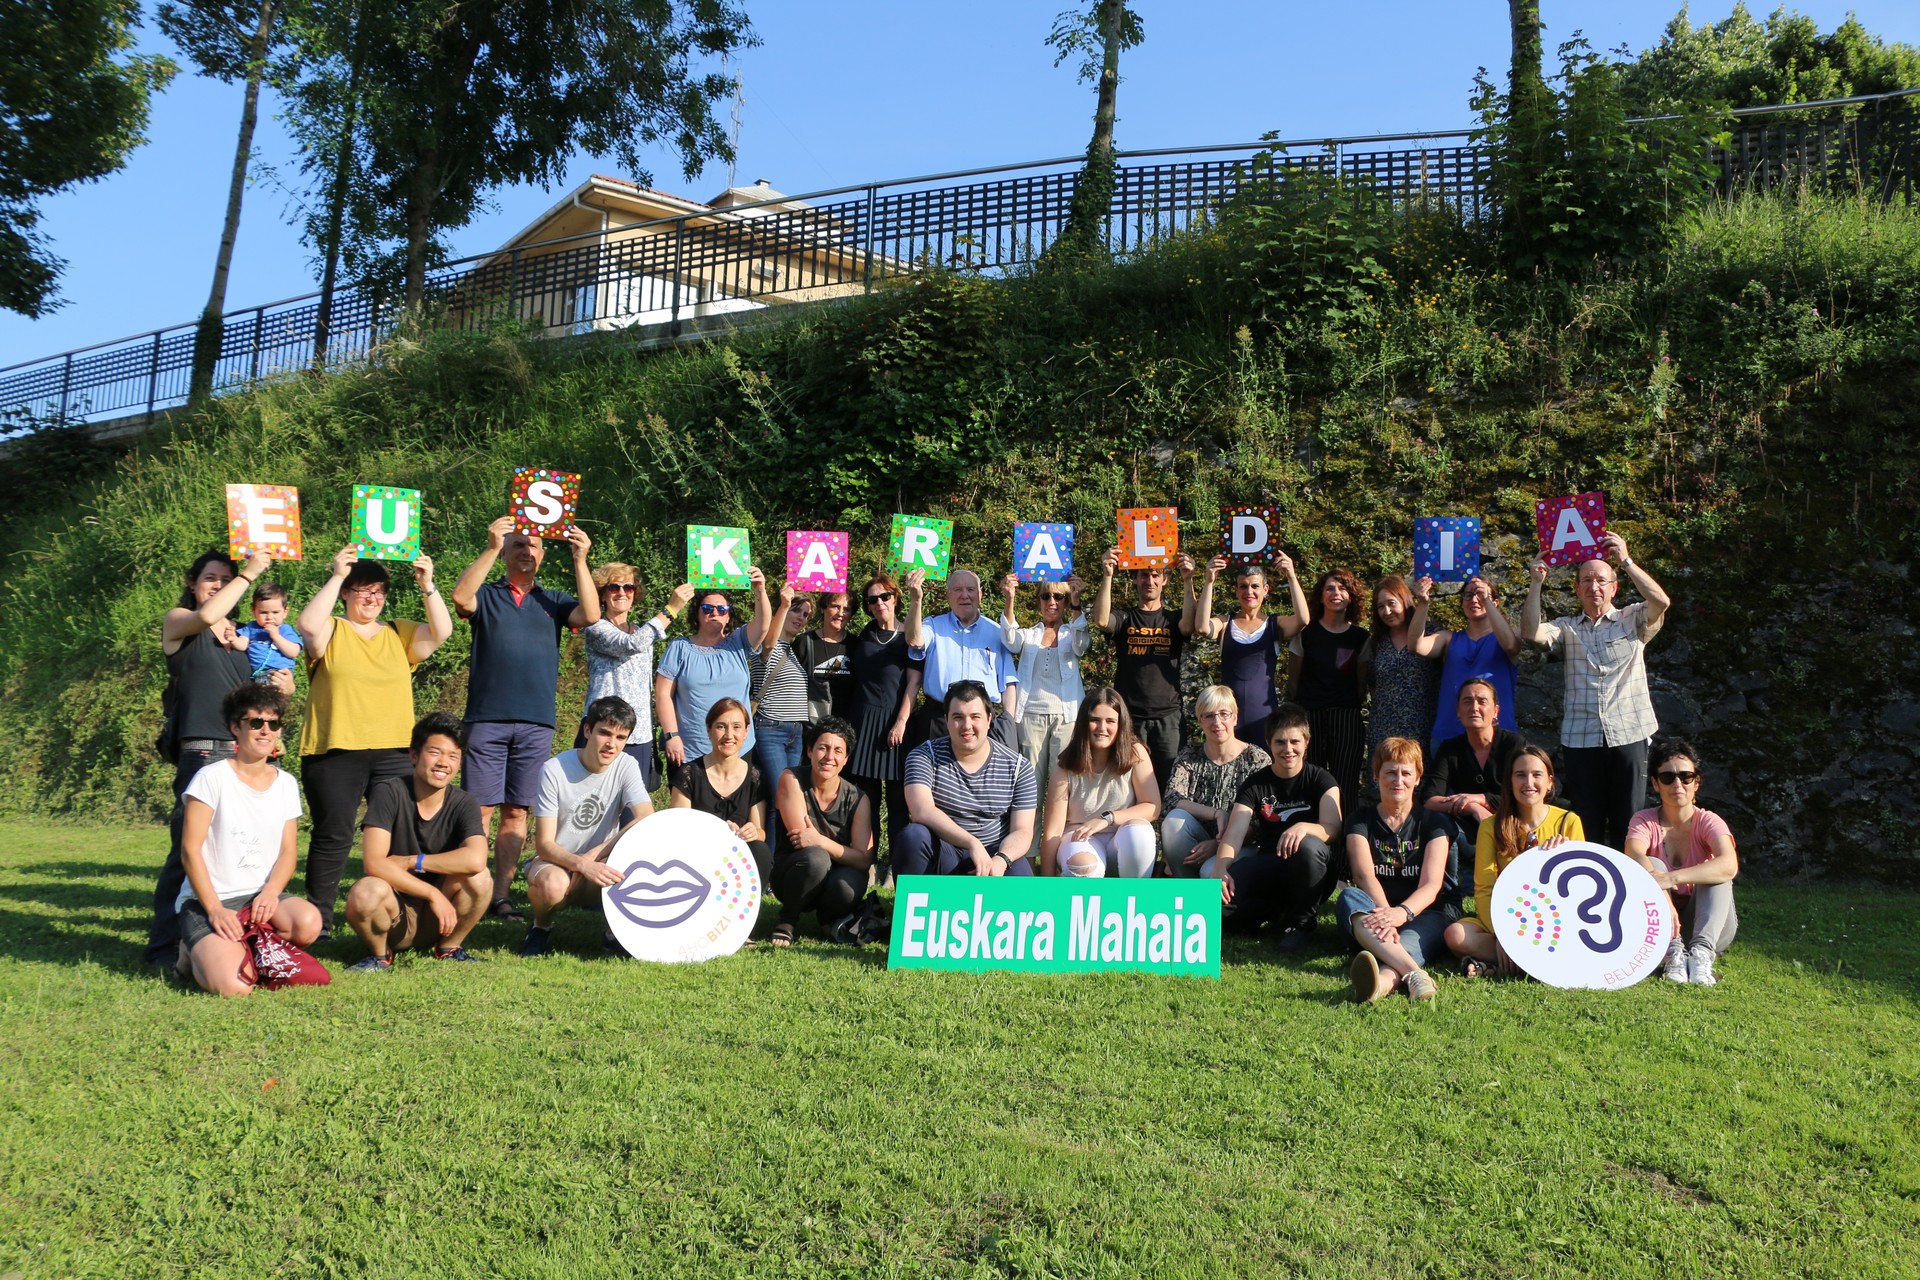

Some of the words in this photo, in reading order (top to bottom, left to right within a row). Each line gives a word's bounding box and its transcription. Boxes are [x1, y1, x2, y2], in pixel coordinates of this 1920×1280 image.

[247, 497, 288, 545] E
[365, 498, 409, 545] U
[524, 481, 564, 525] S
[700, 536, 743, 576] K
[797, 541, 838, 580] A
[902, 526, 939, 567] R
[1023, 532, 1064, 570] A
[1133, 519, 1166, 557] L
[1232, 516, 1268, 554] D
[1439, 531, 1455, 571] I
[1551, 507, 1597, 552] A
[1127, 626, 1171, 636] G-STAR
[1401, 864, 1420, 877] dut
[901, 892, 1055, 961] Euskara
[1067, 895, 1207, 963] Mahaia
